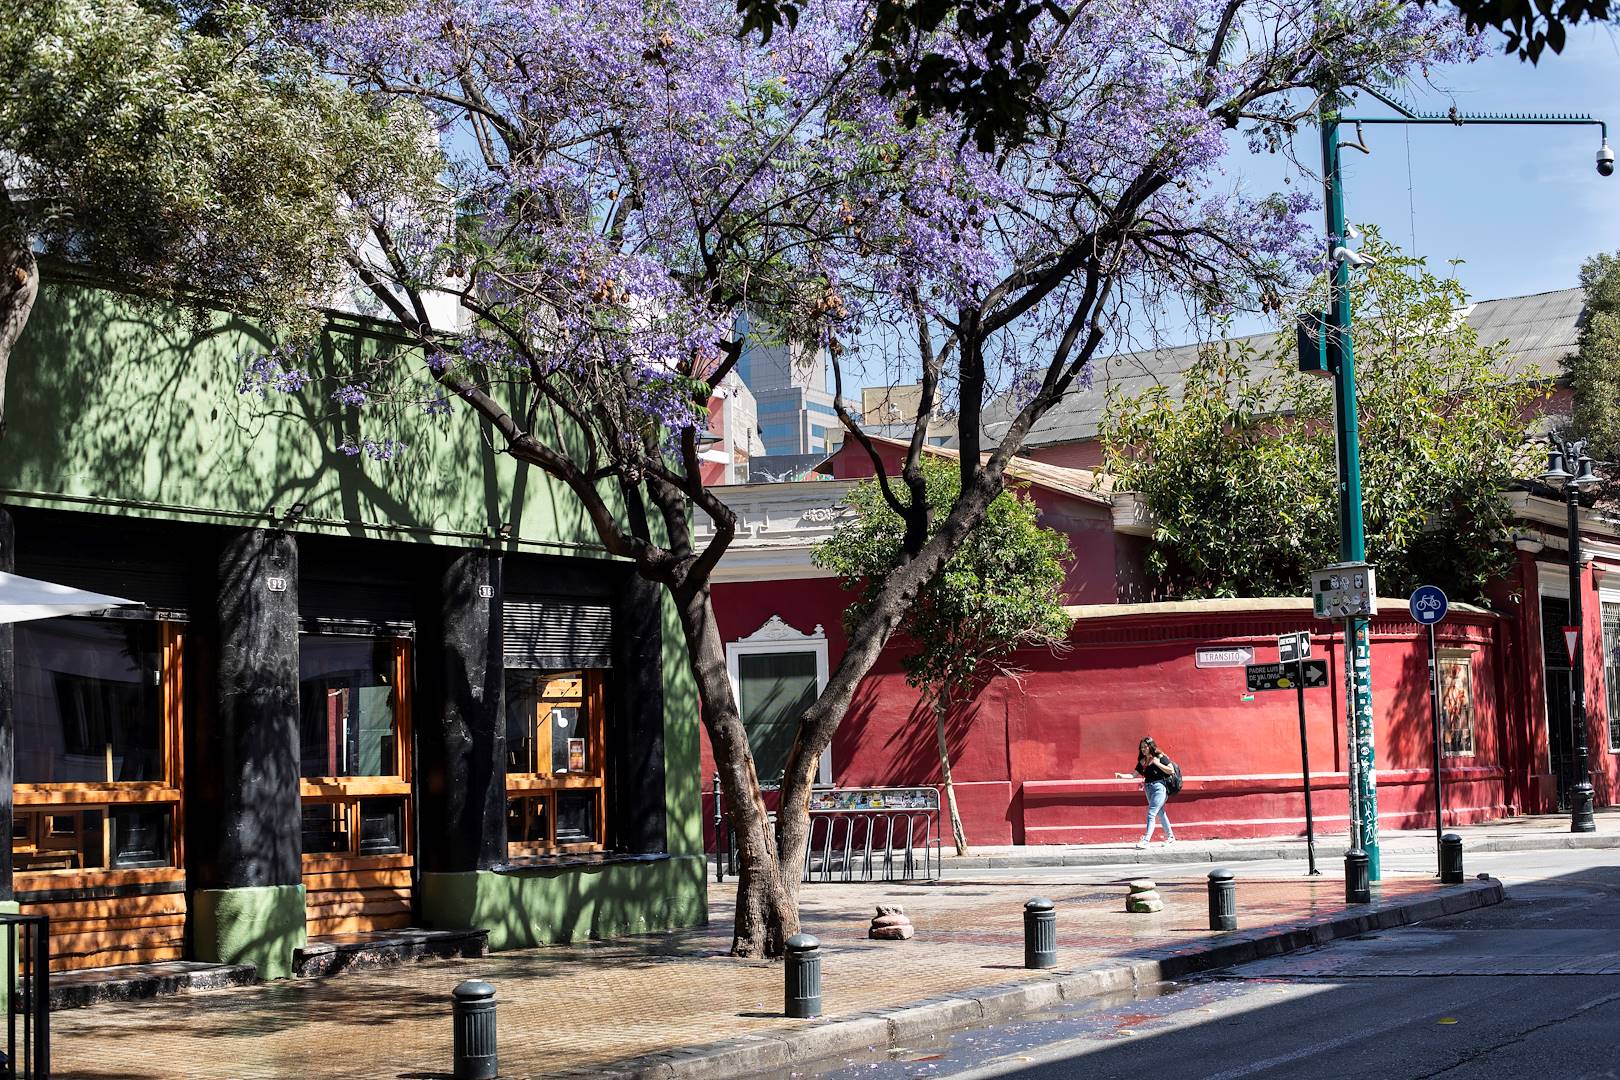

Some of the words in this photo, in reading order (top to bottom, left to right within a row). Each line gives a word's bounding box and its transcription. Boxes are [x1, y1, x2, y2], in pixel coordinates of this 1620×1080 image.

[272, 580, 282, 589] 92
[482, 587, 492, 595] 96
[1204, 652, 1240, 661] TRANSITO
[1248, 666, 1266, 674] PADRE
